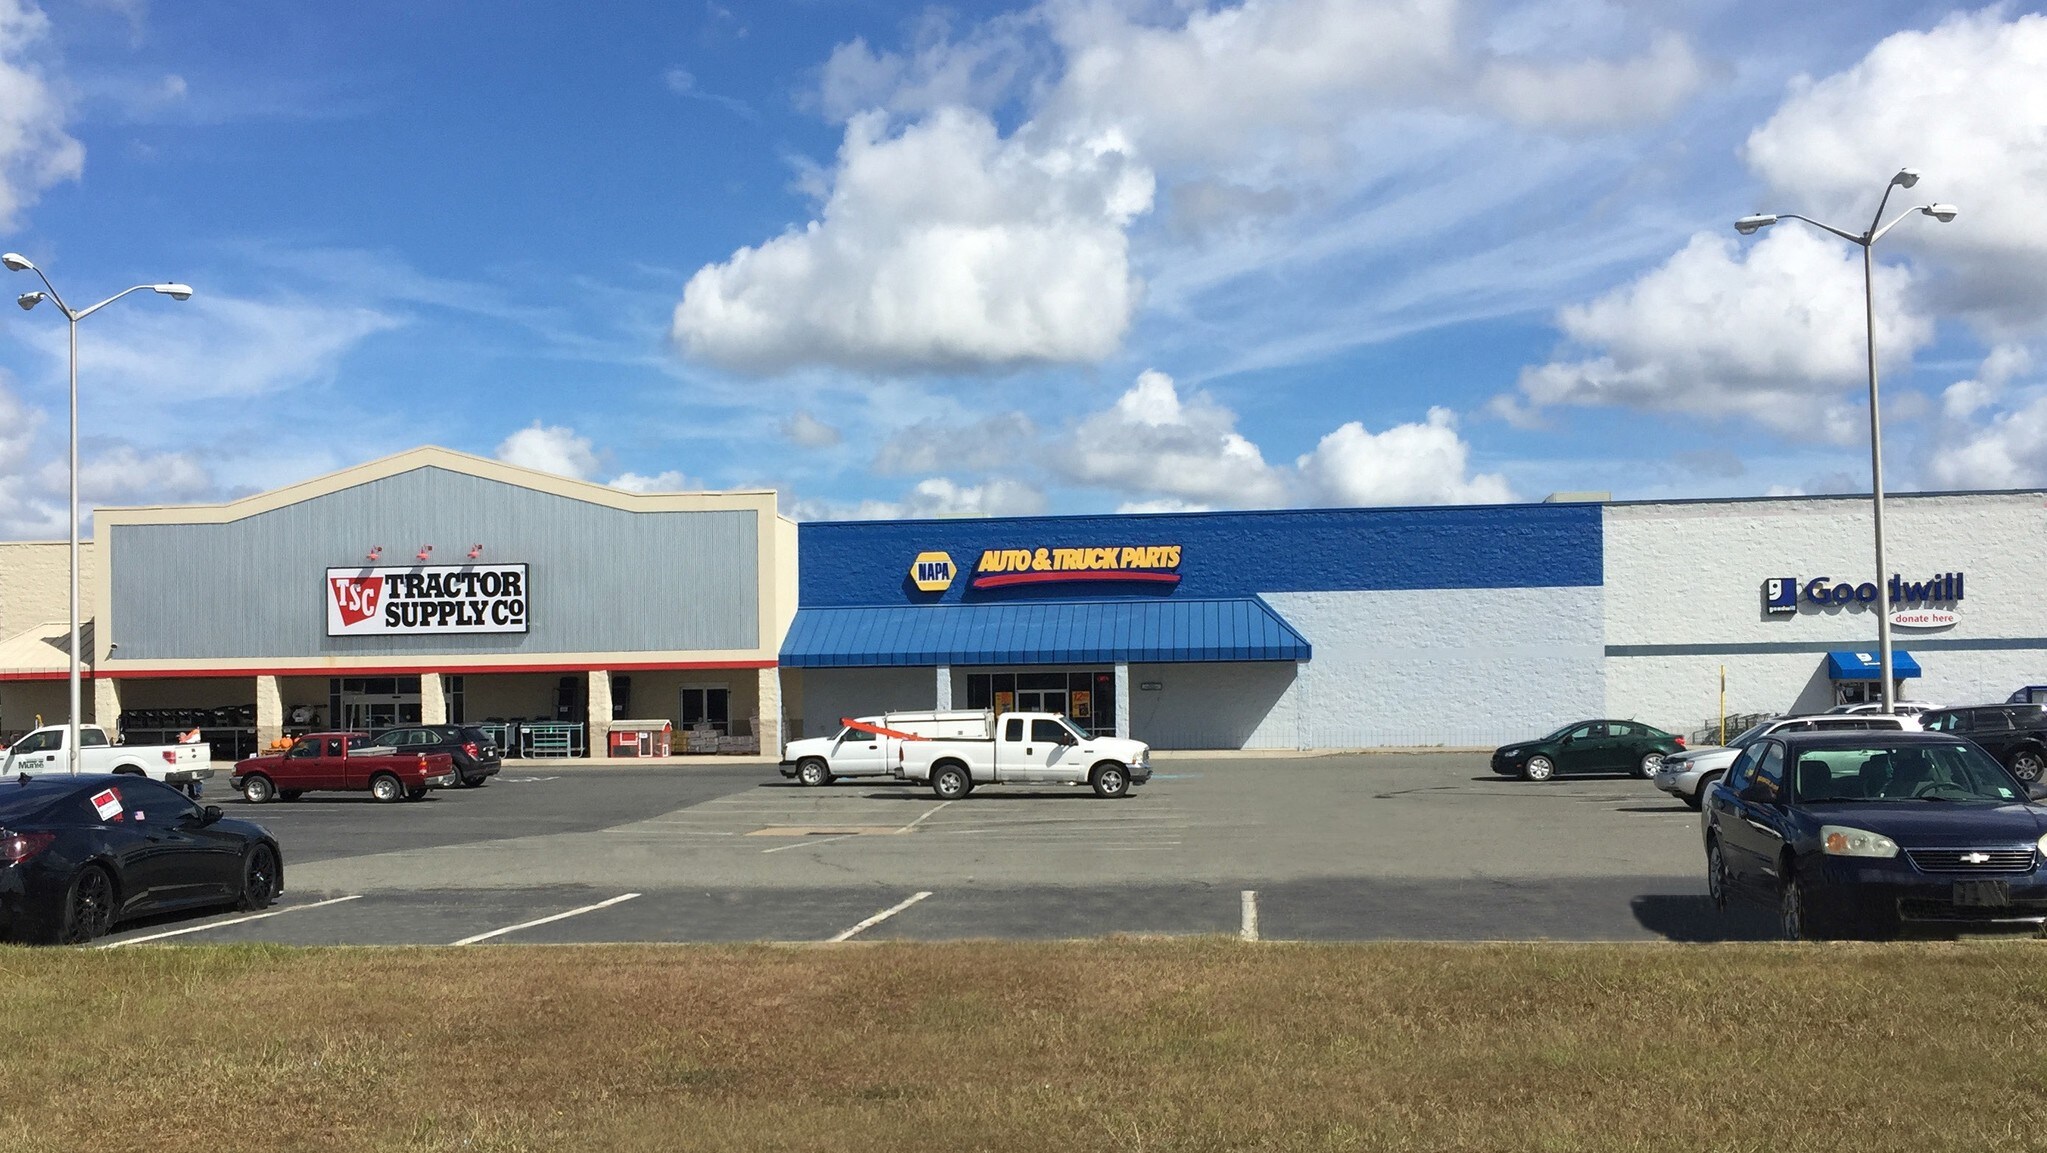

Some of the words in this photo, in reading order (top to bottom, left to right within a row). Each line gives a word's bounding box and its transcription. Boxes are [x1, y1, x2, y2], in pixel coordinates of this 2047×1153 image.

[918, 562, 950, 582] NAPA
[977, 550, 1032, 573] AUTO
[1031, 548, 1052, 571] &
[1051, 547, 1120, 571] TRUCK
[1119, 545, 1182, 569] PARTS
[336, 579, 375, 617] TSC
[385, 572, 522, 599] TRACTOR
[1806, 572, 1964, 605] Goodwill
[385, 600, 489, 627] SUPPLY
[1895, 614, 1929, 623] donate
[1932, 613, 1954, 622] here
